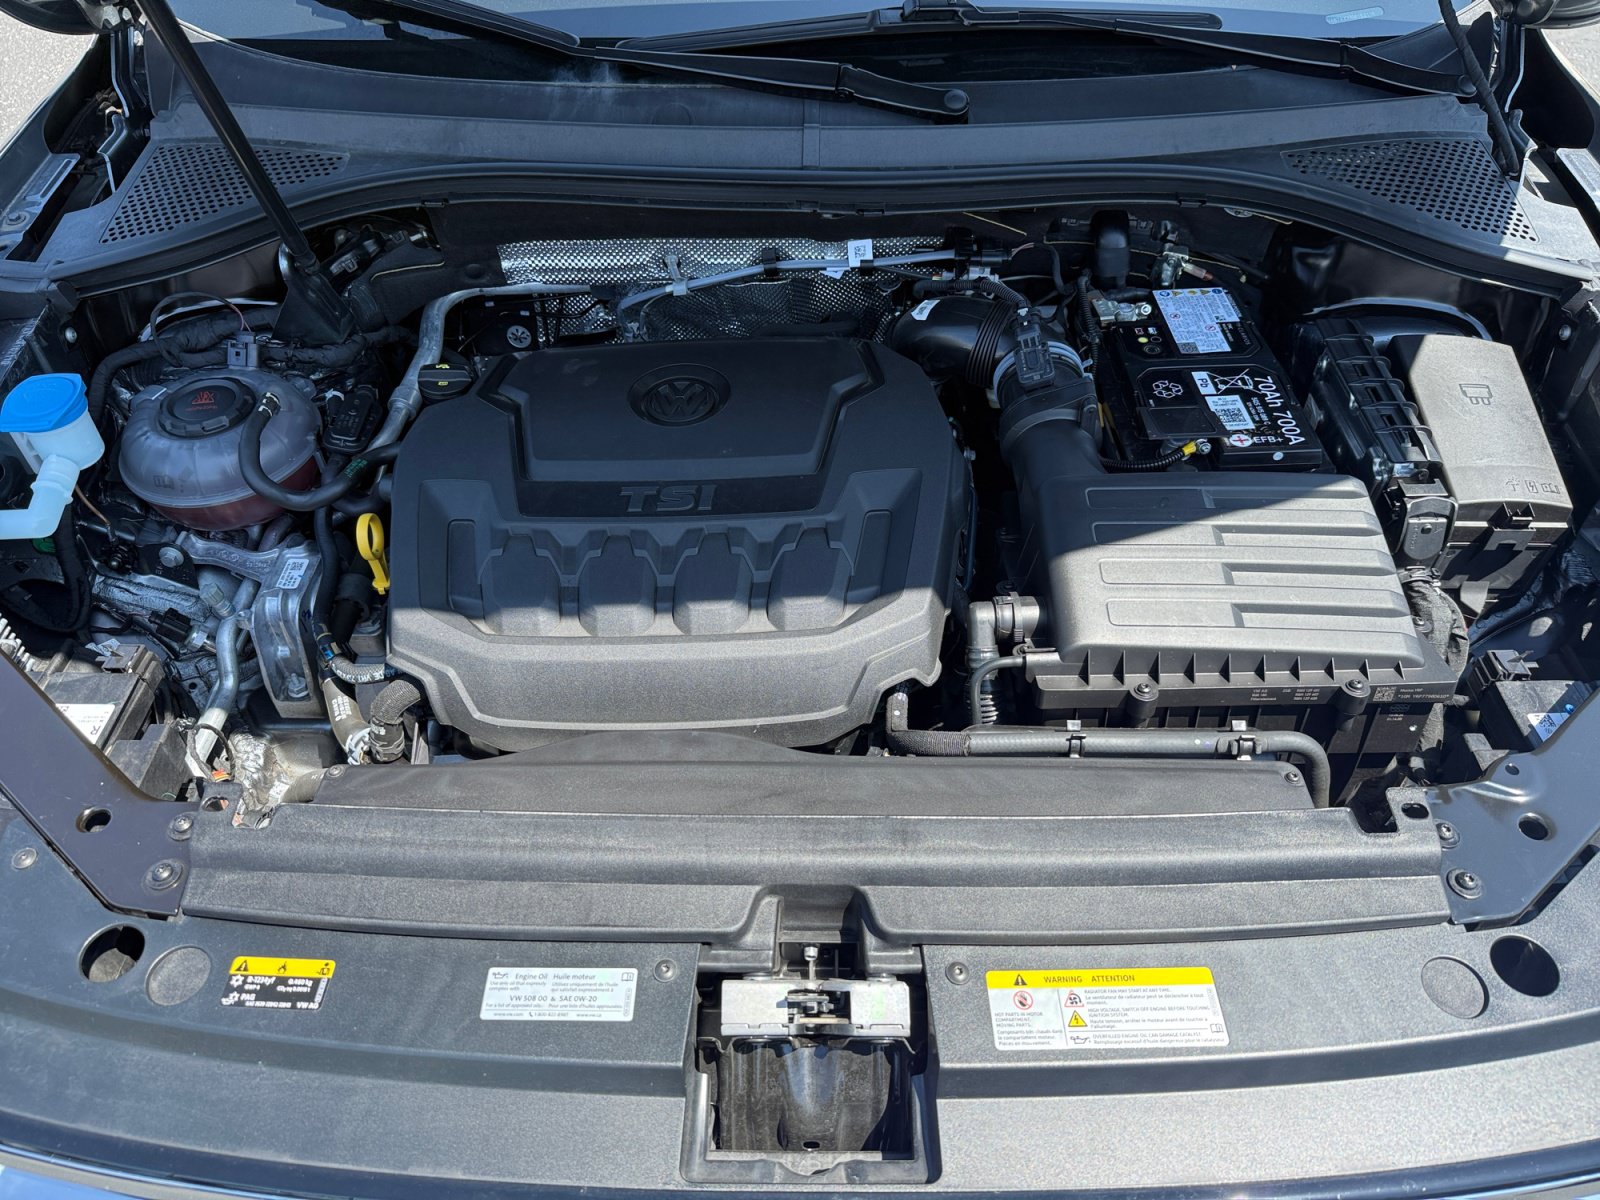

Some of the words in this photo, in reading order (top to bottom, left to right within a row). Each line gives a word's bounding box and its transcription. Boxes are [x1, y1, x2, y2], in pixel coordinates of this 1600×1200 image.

[1197, 378, 1208, 387] Pb
[1254, 376, 1284, 407] 70Ah
[1273, 410, 1306, 445] 700A
[620, 484, 718, 512] TSI
[515, 973, 536, 981] Engine
[1092, 973, 1135, 982] ATTENTION
